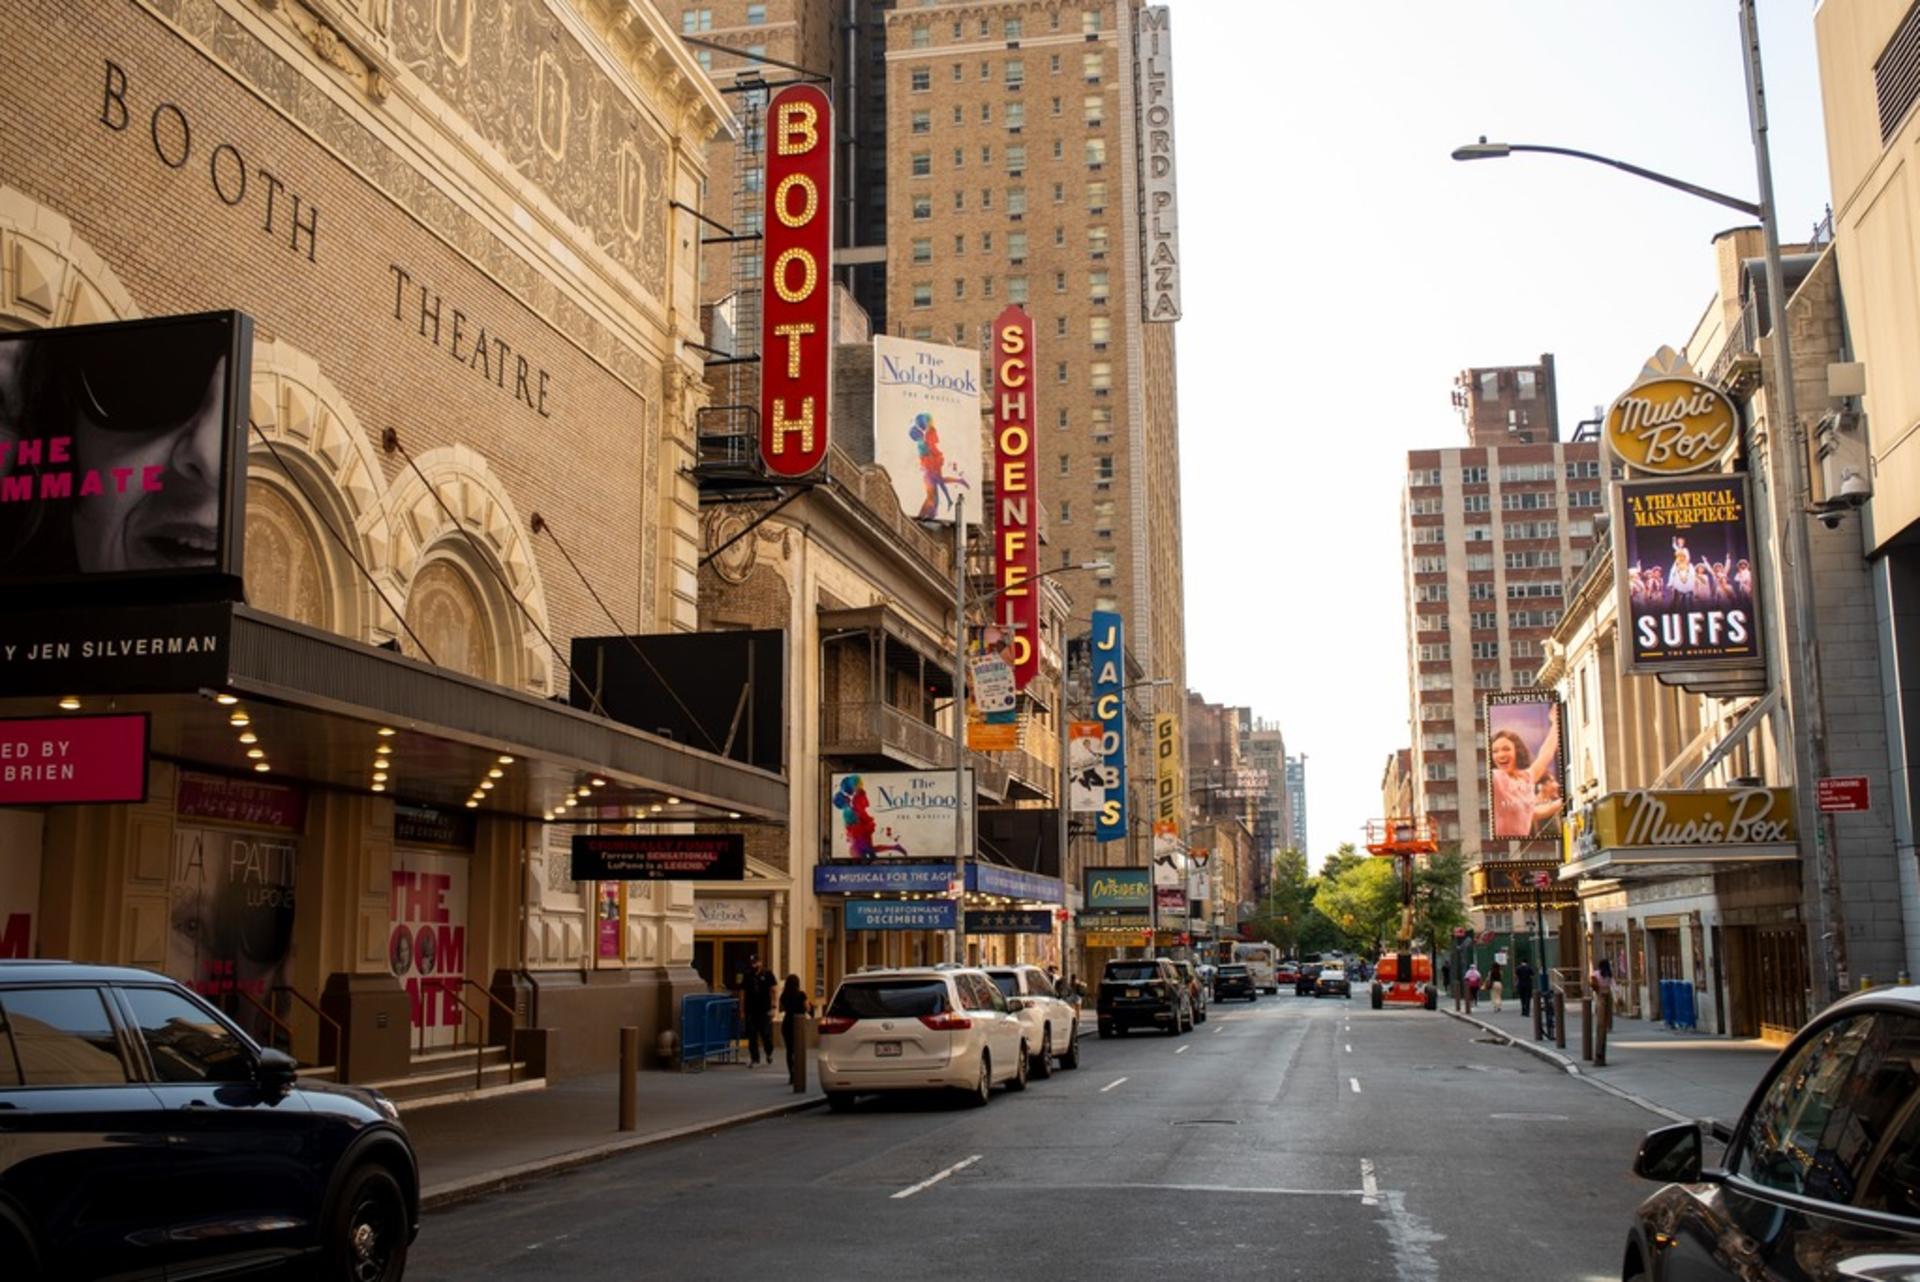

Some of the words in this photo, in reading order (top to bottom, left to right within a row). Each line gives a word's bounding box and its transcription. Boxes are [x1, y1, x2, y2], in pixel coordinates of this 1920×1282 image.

[1142, 9, 1170, 179] MILFORD
[100, 60, 318, 263] BOOTH
[389, 265, 552, 419] THEATRE
[1150, 191, 1178, 318] PLAZA
[772, 101, 818, 454] BOOTH
[879, 354, 977, 393] Notebook
[916, 352, 944, 367] The
[1618, 386, 1716, 433] Music
[1638, 421, 1727, 465] Box
[1000, 325, 1031, 665] SCHOENFELD
[1642, 489, 1736, 512] THEATRICAL
[27, 642, 71, 660] JEN
[82, 635, 217, 659] SILVERMAN
[1637, 610, 1747, 648] SUFFS
[1492, 694, 1552, 705] IMPERIAL
[1097, 626, 1122, 826] JACOBS
[42, 740, 71, 758] BY
[4, 764, 75, 781] BRIEN
[909, 779, 936, 789] The
[1623, 790, 1725, 845] Music
[1724, 788, 1788, 844] Box
[230, 840, 296, 887] PATTI
[839, 872, 884, 883] MUSICAL
[886, 872, 908, 882] FOR
[910, 871, 931, 881] THE
[857, 906, 883, 914] FINAL
[884, 905, 949, 915] PERFORMANCE
[866, 914, 924, 925] DECEMBER
[927, 914, 940, 924] 15
